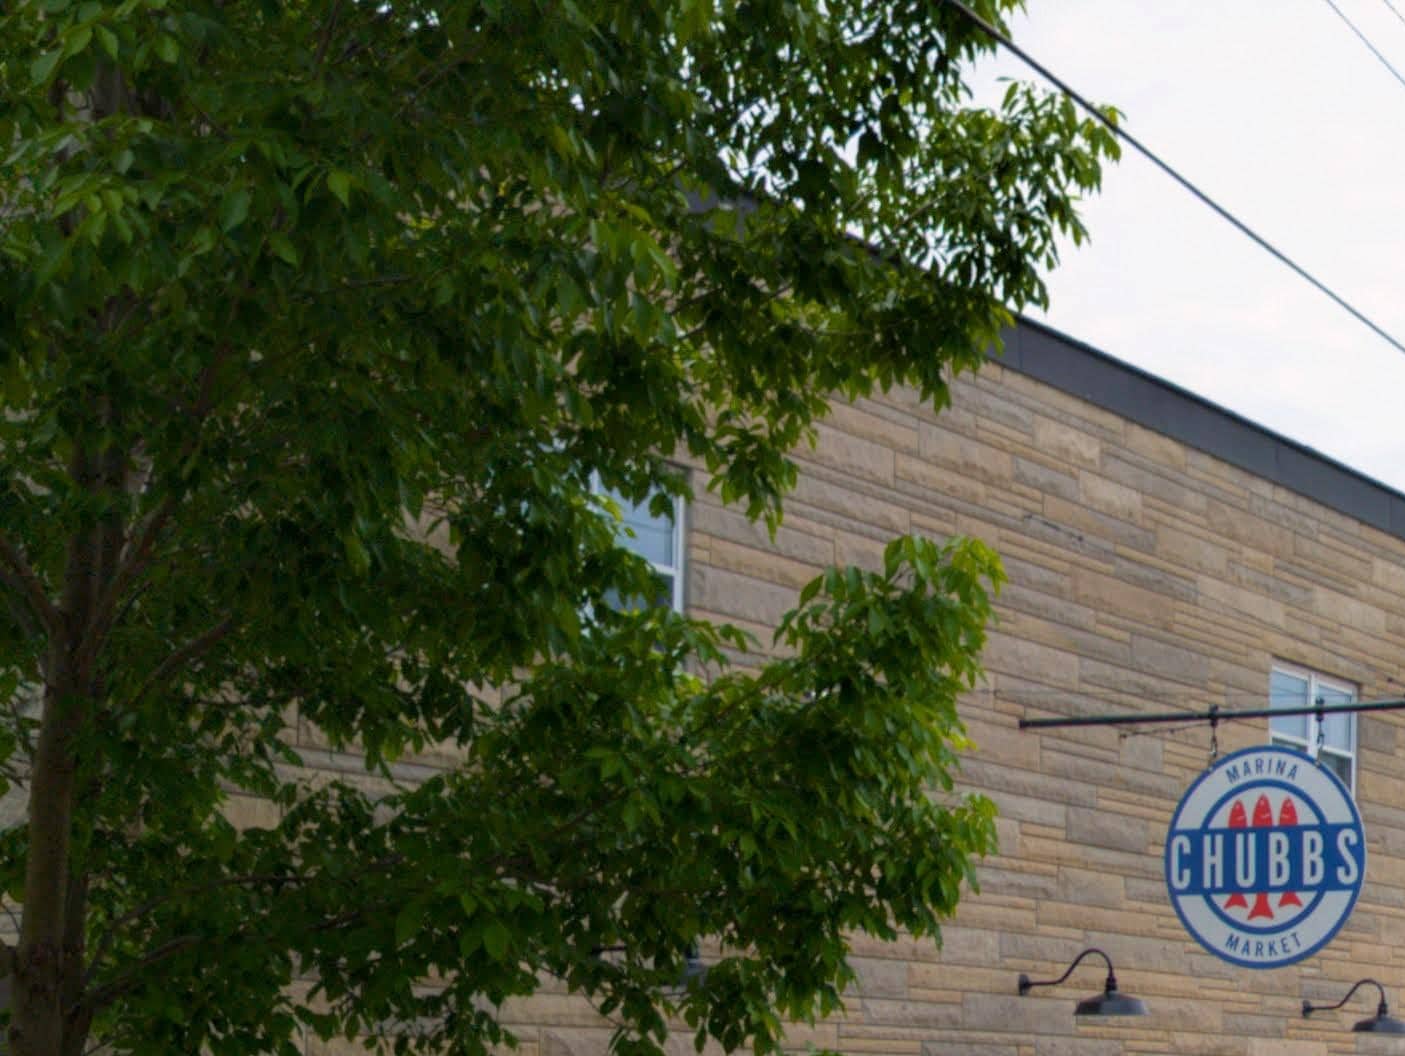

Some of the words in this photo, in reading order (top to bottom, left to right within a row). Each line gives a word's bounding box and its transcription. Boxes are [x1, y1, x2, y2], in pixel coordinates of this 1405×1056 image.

[1226, 758, 1298, 784] MARINA
[1170, 828, 1359, 890] CHUBBS
[1225, 932, 1302, 957] MARKET
